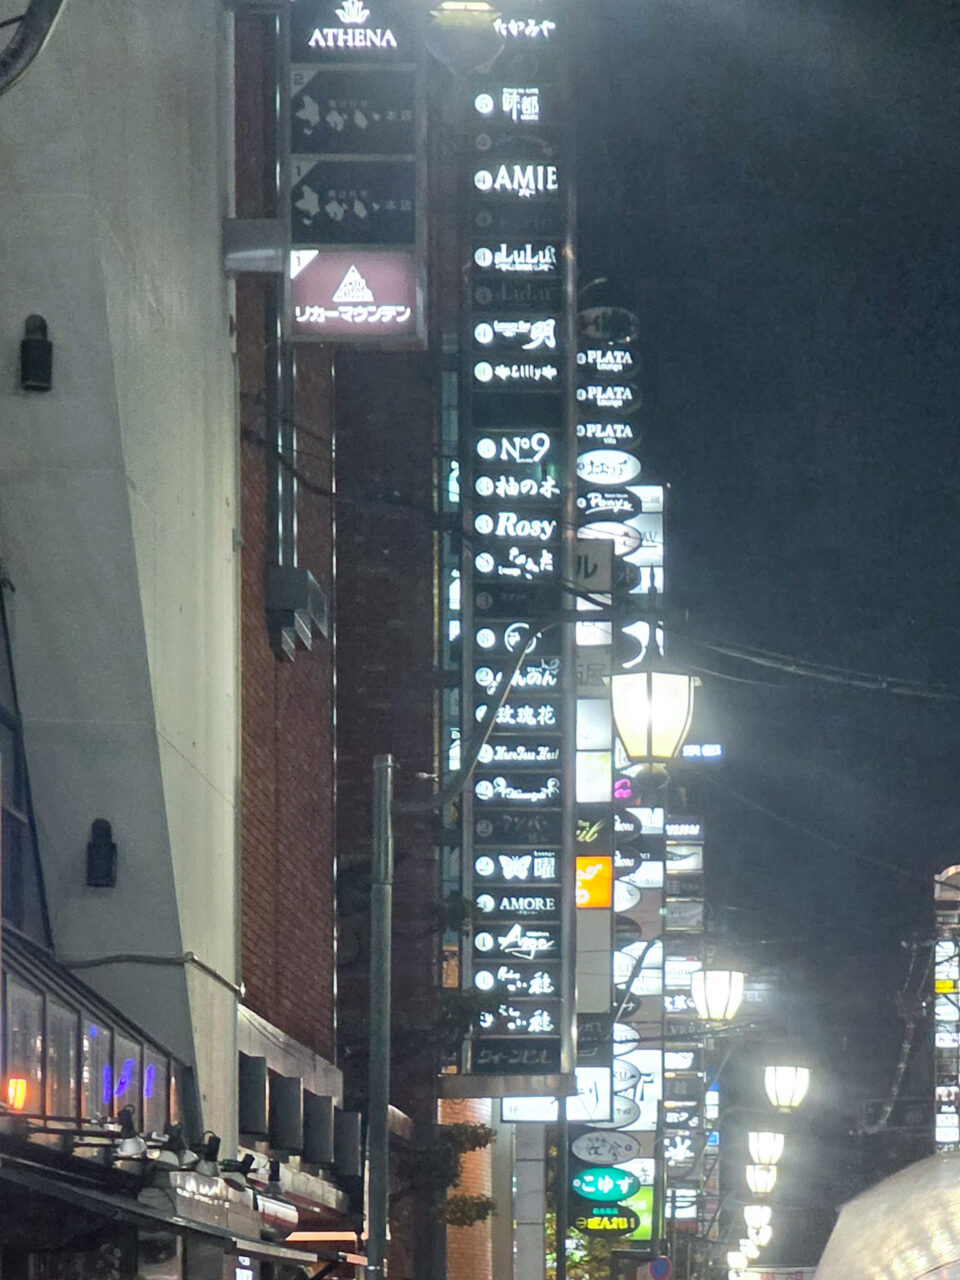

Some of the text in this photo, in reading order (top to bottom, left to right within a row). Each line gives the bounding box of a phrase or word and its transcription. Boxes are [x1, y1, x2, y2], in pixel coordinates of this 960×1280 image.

[308, 28, 398, 48] ATHENA
[494, 164, 558, 191] AMIE
[295, 305, 411, 323] リカーマウンテン
[587, 350, 633, 364] PLATA
[587, 386, 633, 400] PLATA
[586, 424, 633, 438] PLATA
[495, 511, 557, 541] Rosy
[499, 897, 556, 911] AMORE
